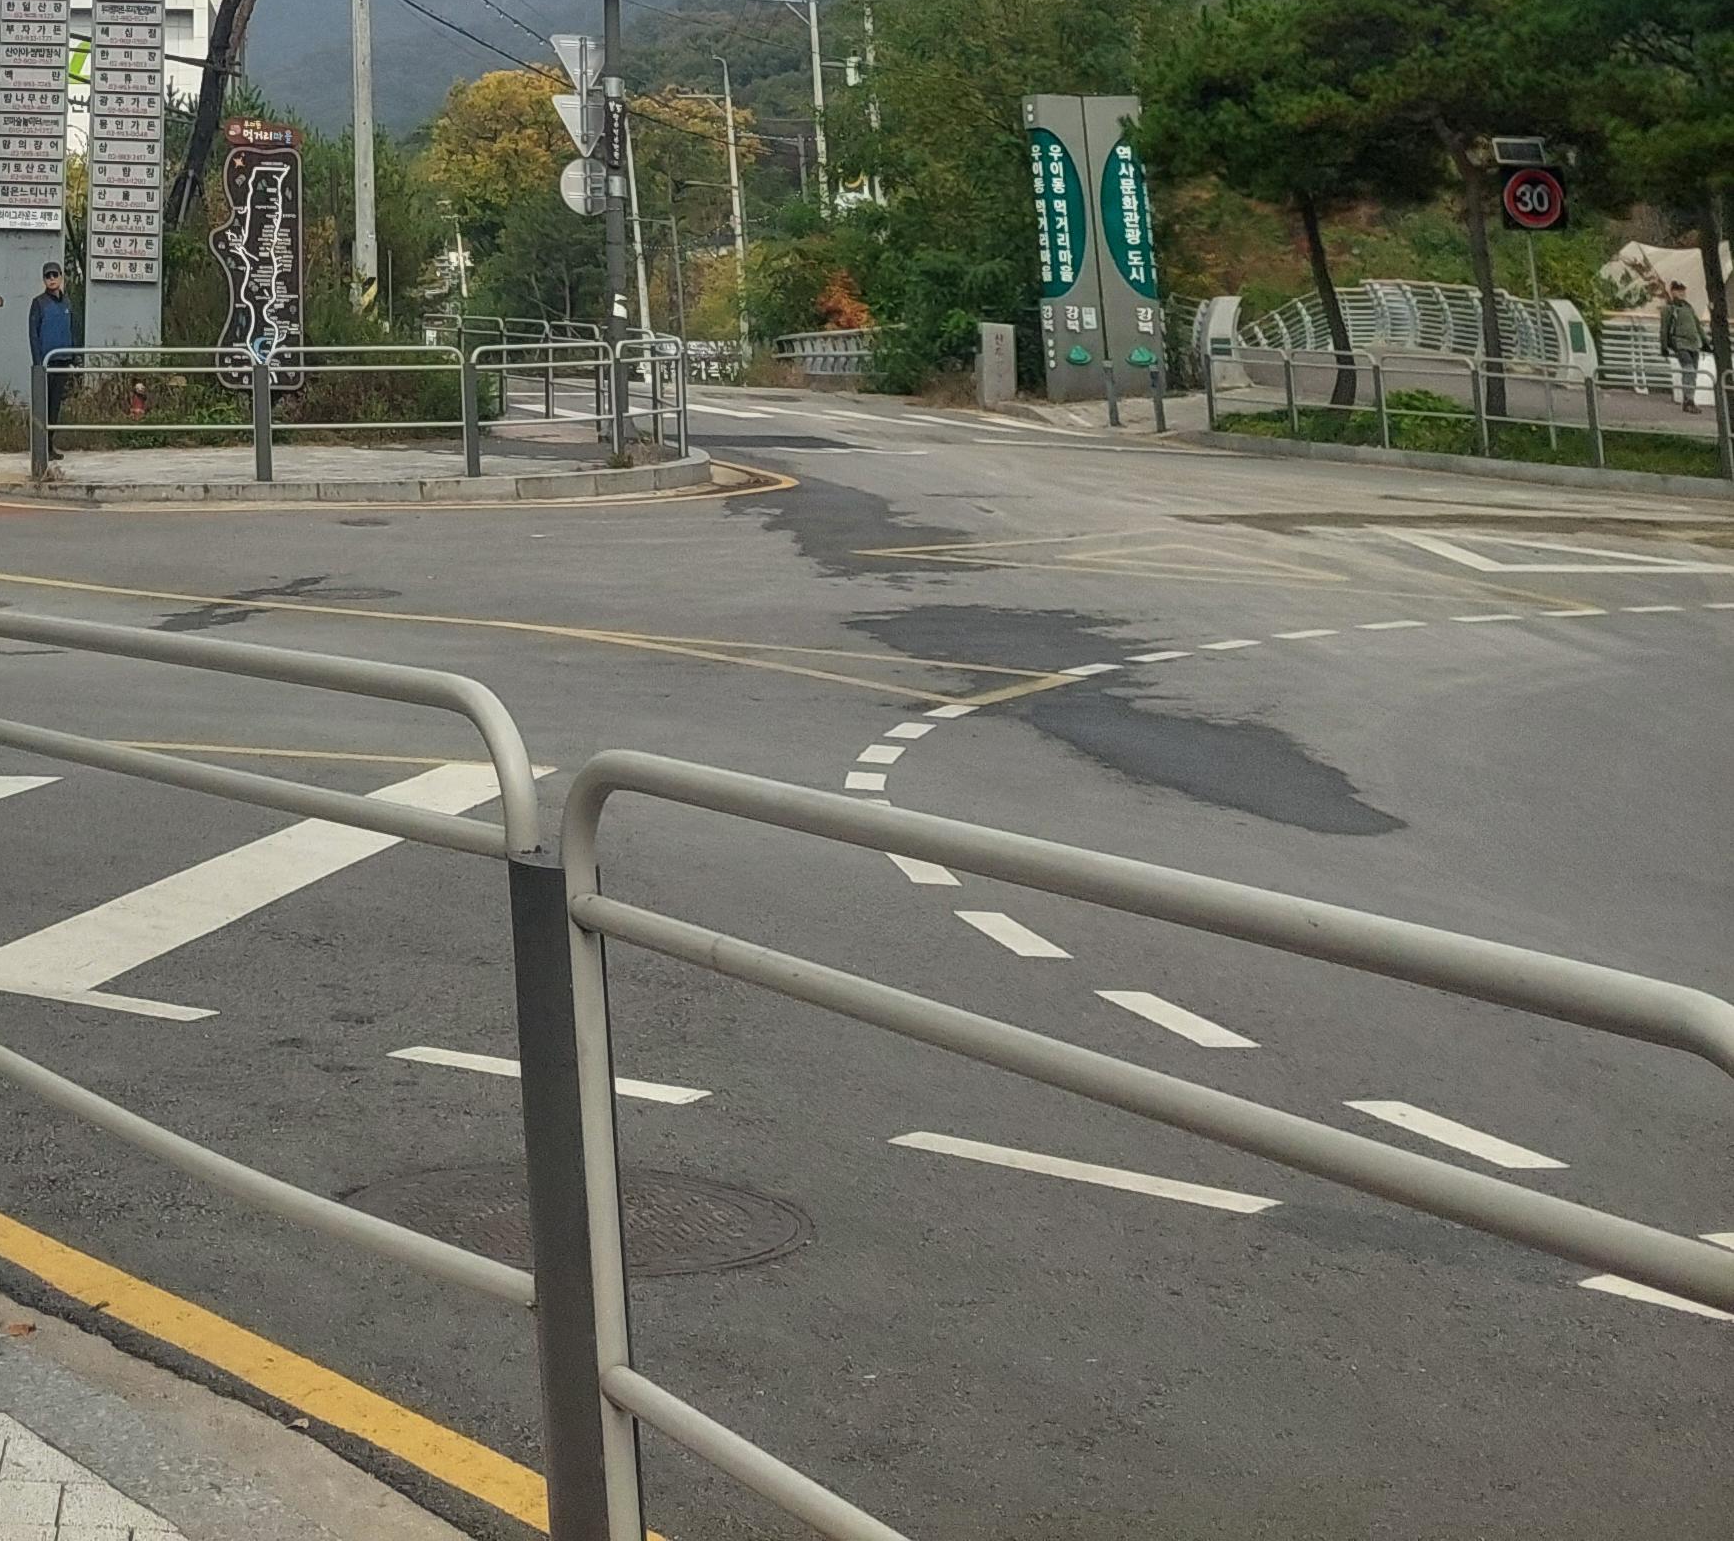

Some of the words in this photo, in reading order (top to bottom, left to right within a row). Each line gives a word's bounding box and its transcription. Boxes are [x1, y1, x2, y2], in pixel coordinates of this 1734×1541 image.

[5, 24, 62, 36] 부자가든
[98, 95, 157, 108] 광주가든
[243, 128, 293, 144] 먹거리마을
[1, 162, 59, 174] 키토산오리
[1030, 144, 1046, 194] 우이동
[1048, 144, 1066, 194] 우이동
[1115, 145, 1142, 245] 역사문화관광
[1516, 183, 1549, 213] 30
[96, 212, 154, 226] 대추나무집
[1035, 199, 1053, 283] 먹거리마을
[1053, 199, 1074, 283] 먹거리마을
[1128, 250, 1146, 283] 도시
[1065, 305, 1081, 333] 강북
[1135, 306, 1154, 336] 강북
